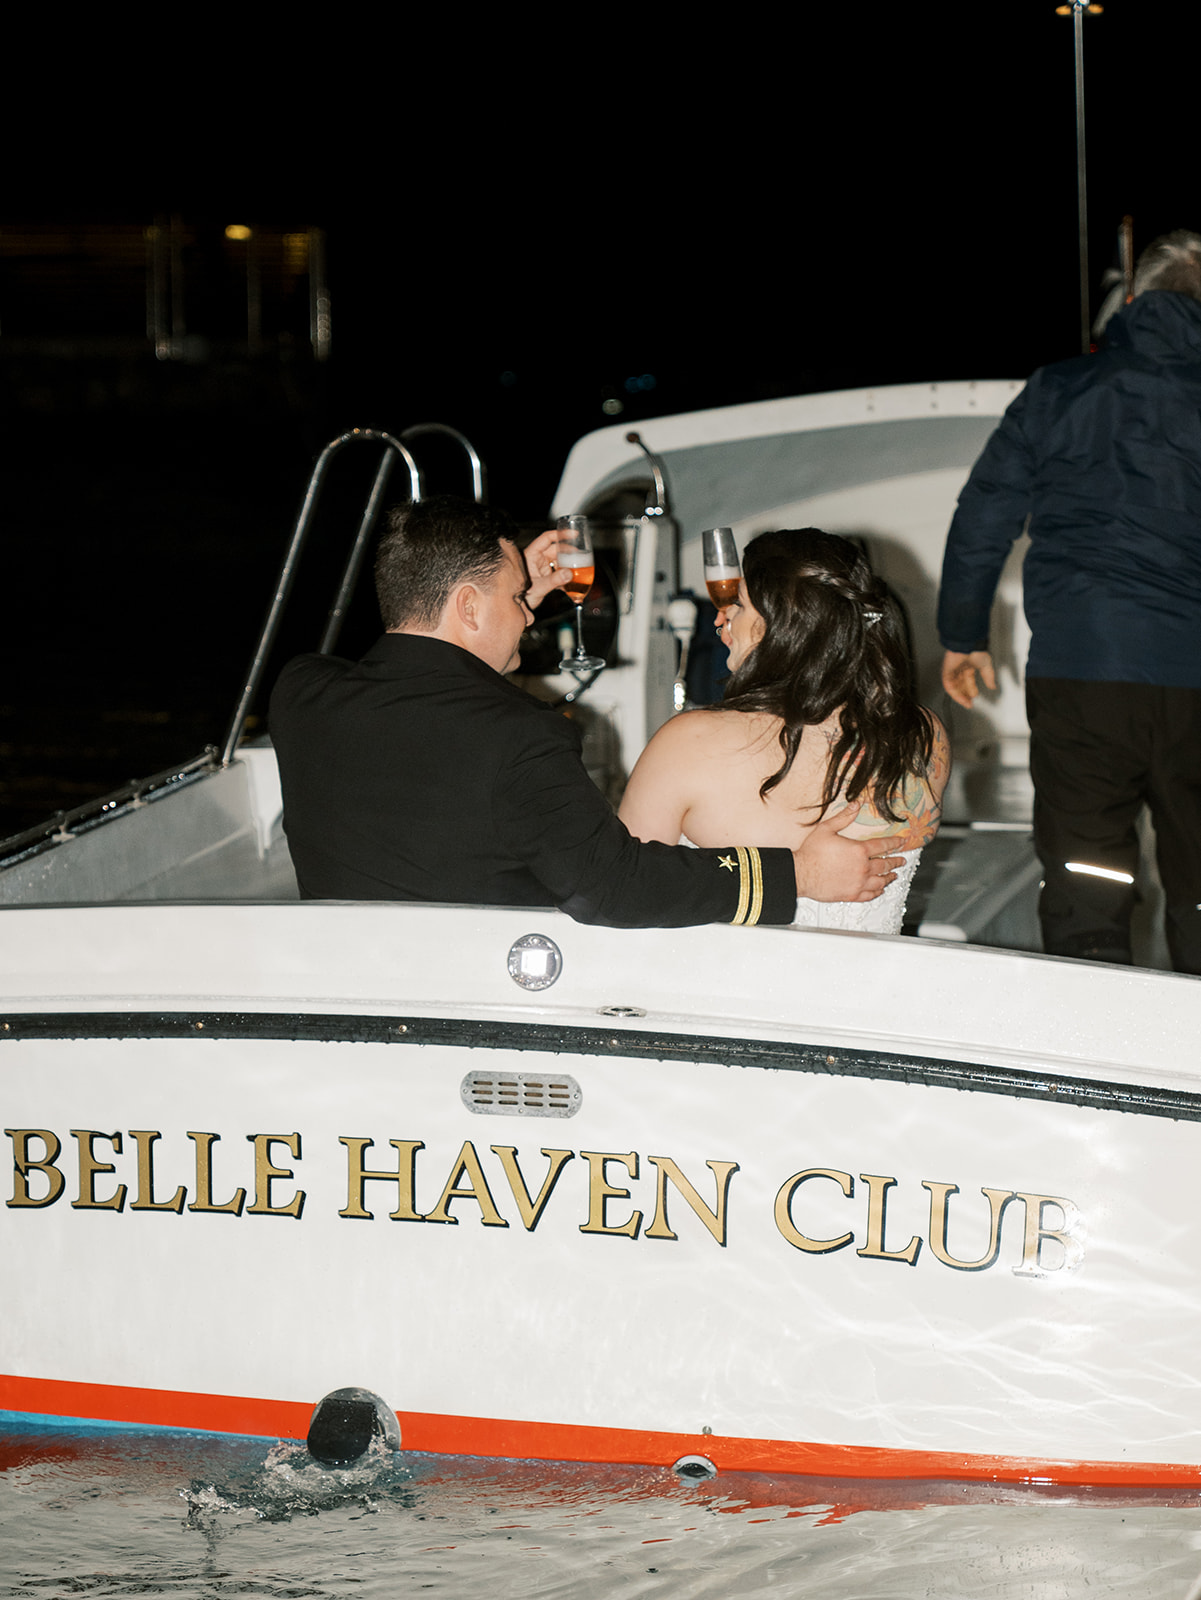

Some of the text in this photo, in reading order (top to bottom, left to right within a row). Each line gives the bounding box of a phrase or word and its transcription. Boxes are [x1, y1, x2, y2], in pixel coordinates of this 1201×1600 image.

[4, 1128, 1086, 1279] BELLE HAVEN CLUB
